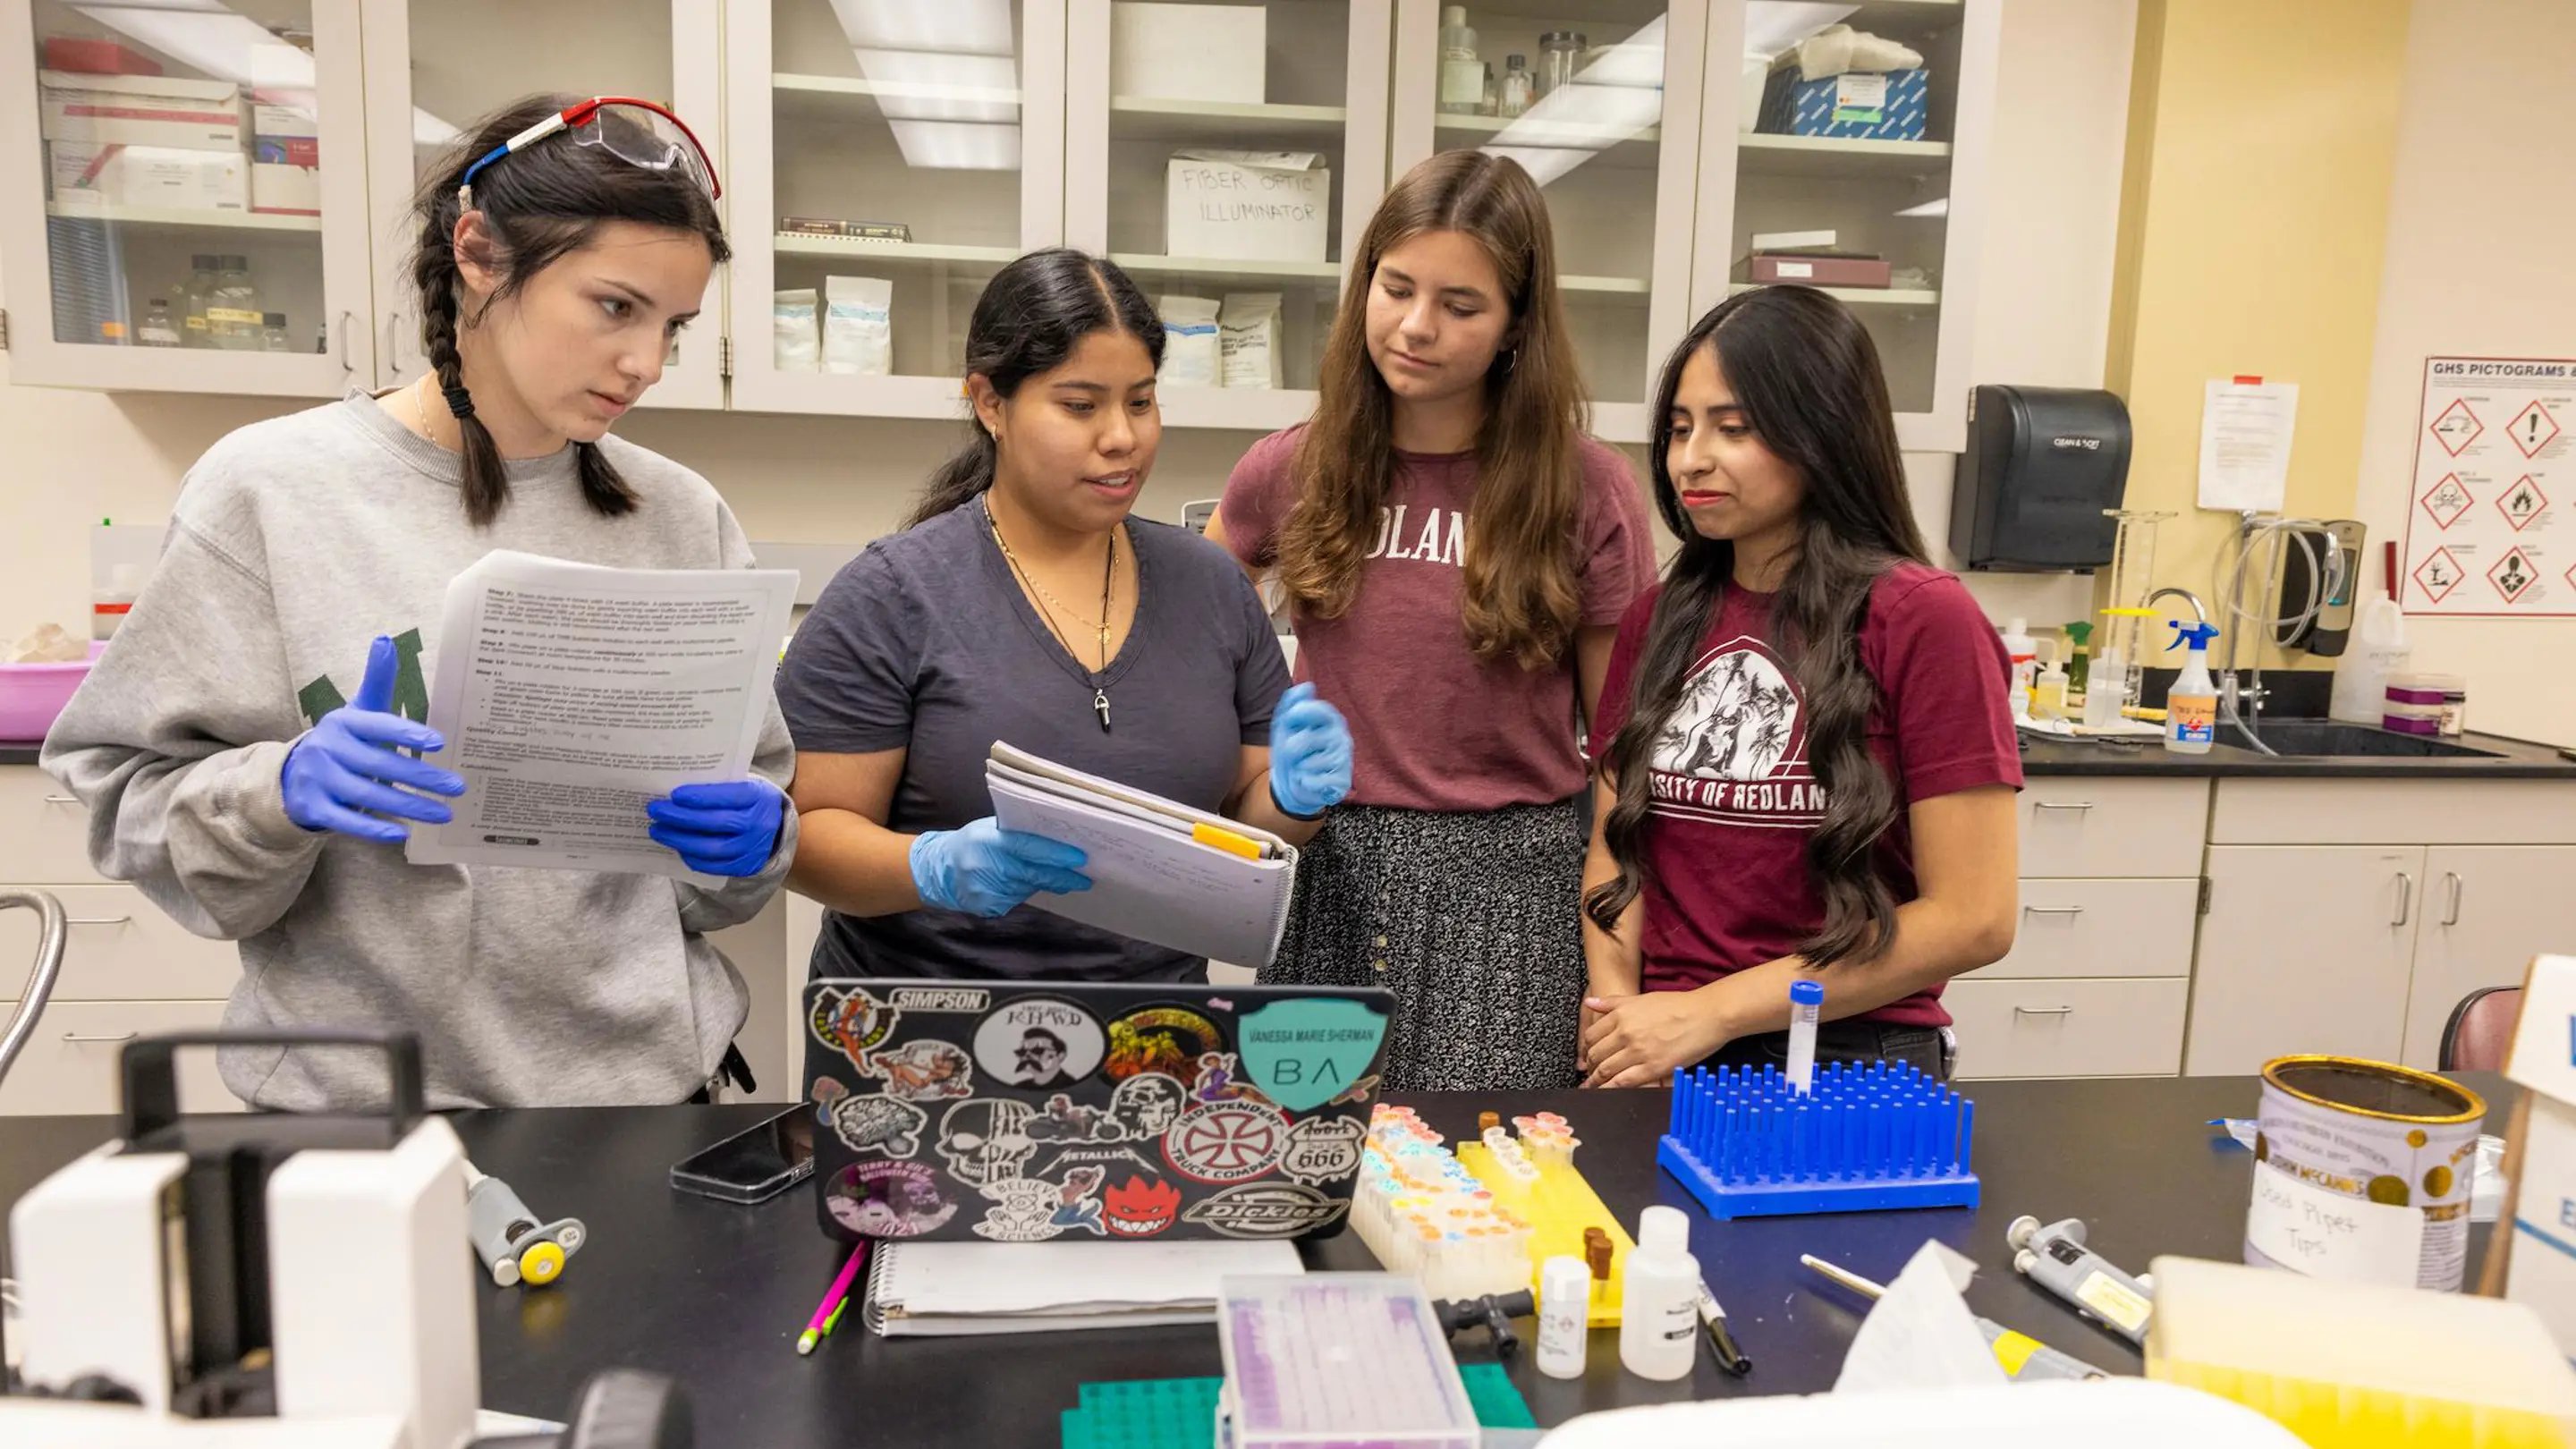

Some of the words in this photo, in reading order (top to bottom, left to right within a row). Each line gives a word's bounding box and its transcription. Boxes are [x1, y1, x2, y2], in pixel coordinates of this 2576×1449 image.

[1182, 169, 1247, 191] FIBER
[1259, 174, 1314, 191] OPTIC
[1199, 201, 1316, 222] ILLUMINATOR
[2433, 363, 2464, 374] GHS
[2469, 363, 2565, 377] PICTOGRAMS
[1701, 781, 1730, 808] OF
[897, 991, 983, 1009] SIMPSON
[1249, 1030, 1293, 1043] VANESSA
[1295, 1030, 1326, 1043] MARIE
[1326, 1029, 1375, 1043] SHERMAN
[1179, 1101, 1284, 1128] INDEPENDENT
[1170, 1148, 1208, 1176] TRUCK
[1213, 1149, 1281, 1179] COMPANY
[1298, 1148, 1346, 1168] 666
[995, 1182, 1059, 1200] BELIEVE
[1204, 1205, 1330, 1218] Dickies
[996, 1225, 1059, 1241] SCIENCE
[2285, 1227, 2327, 1257] Tips
